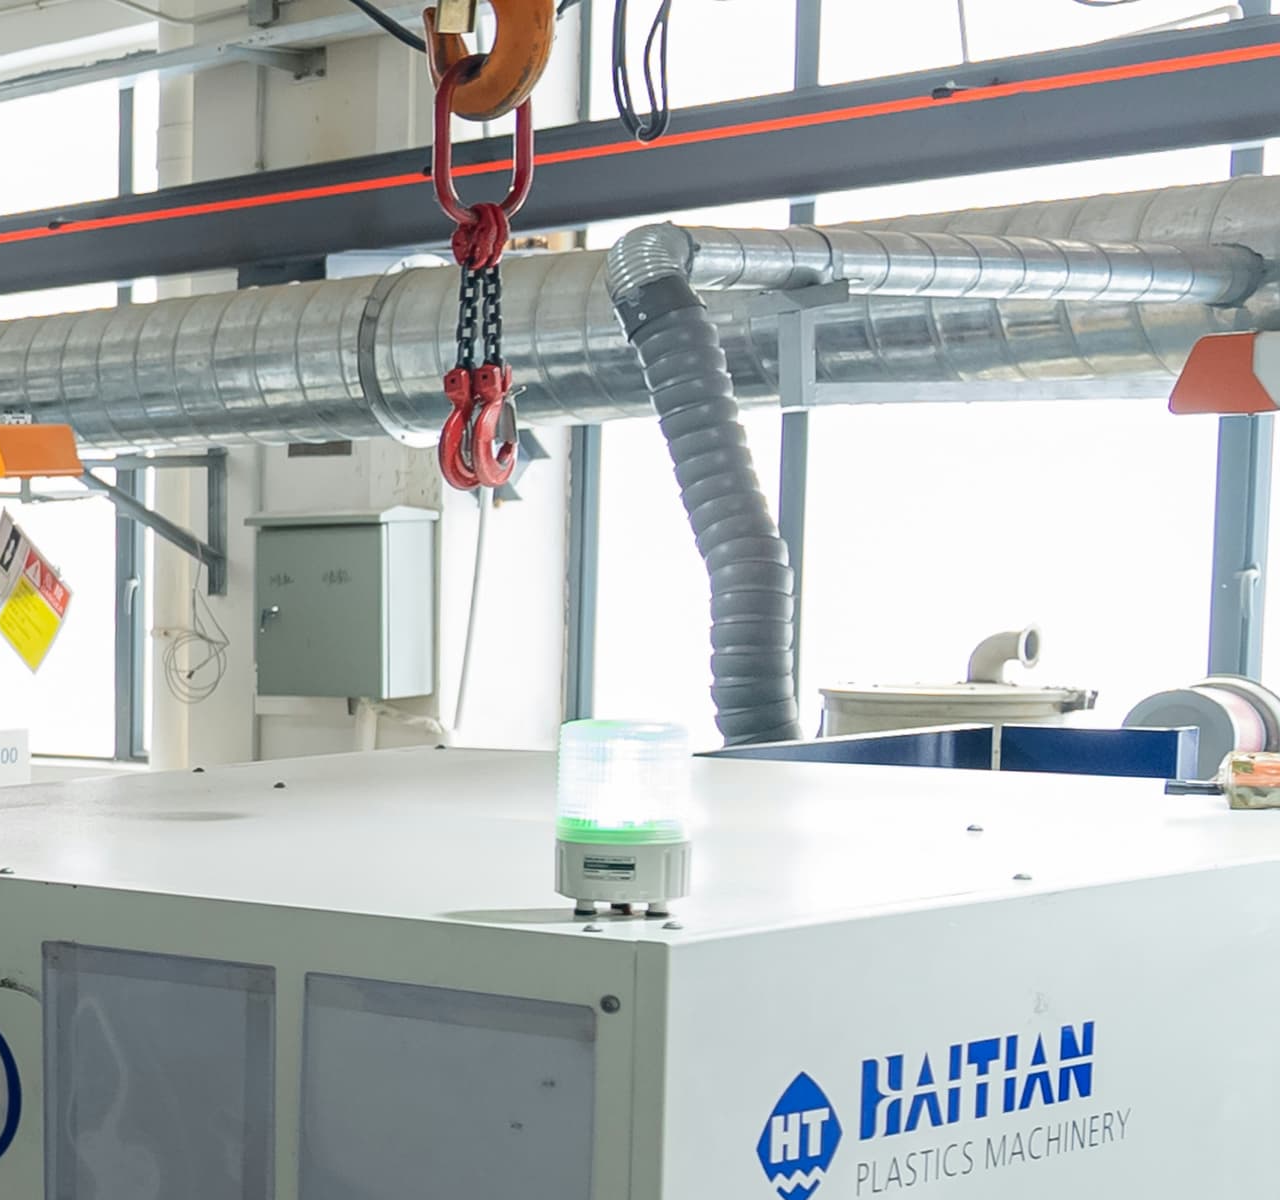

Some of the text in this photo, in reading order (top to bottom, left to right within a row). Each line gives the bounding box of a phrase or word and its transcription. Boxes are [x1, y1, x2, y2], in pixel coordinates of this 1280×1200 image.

[858, 1020, 1096, 1141] HAITIAN
[856, 1107, 1132, 1197] PLASTICS MACHINERY
